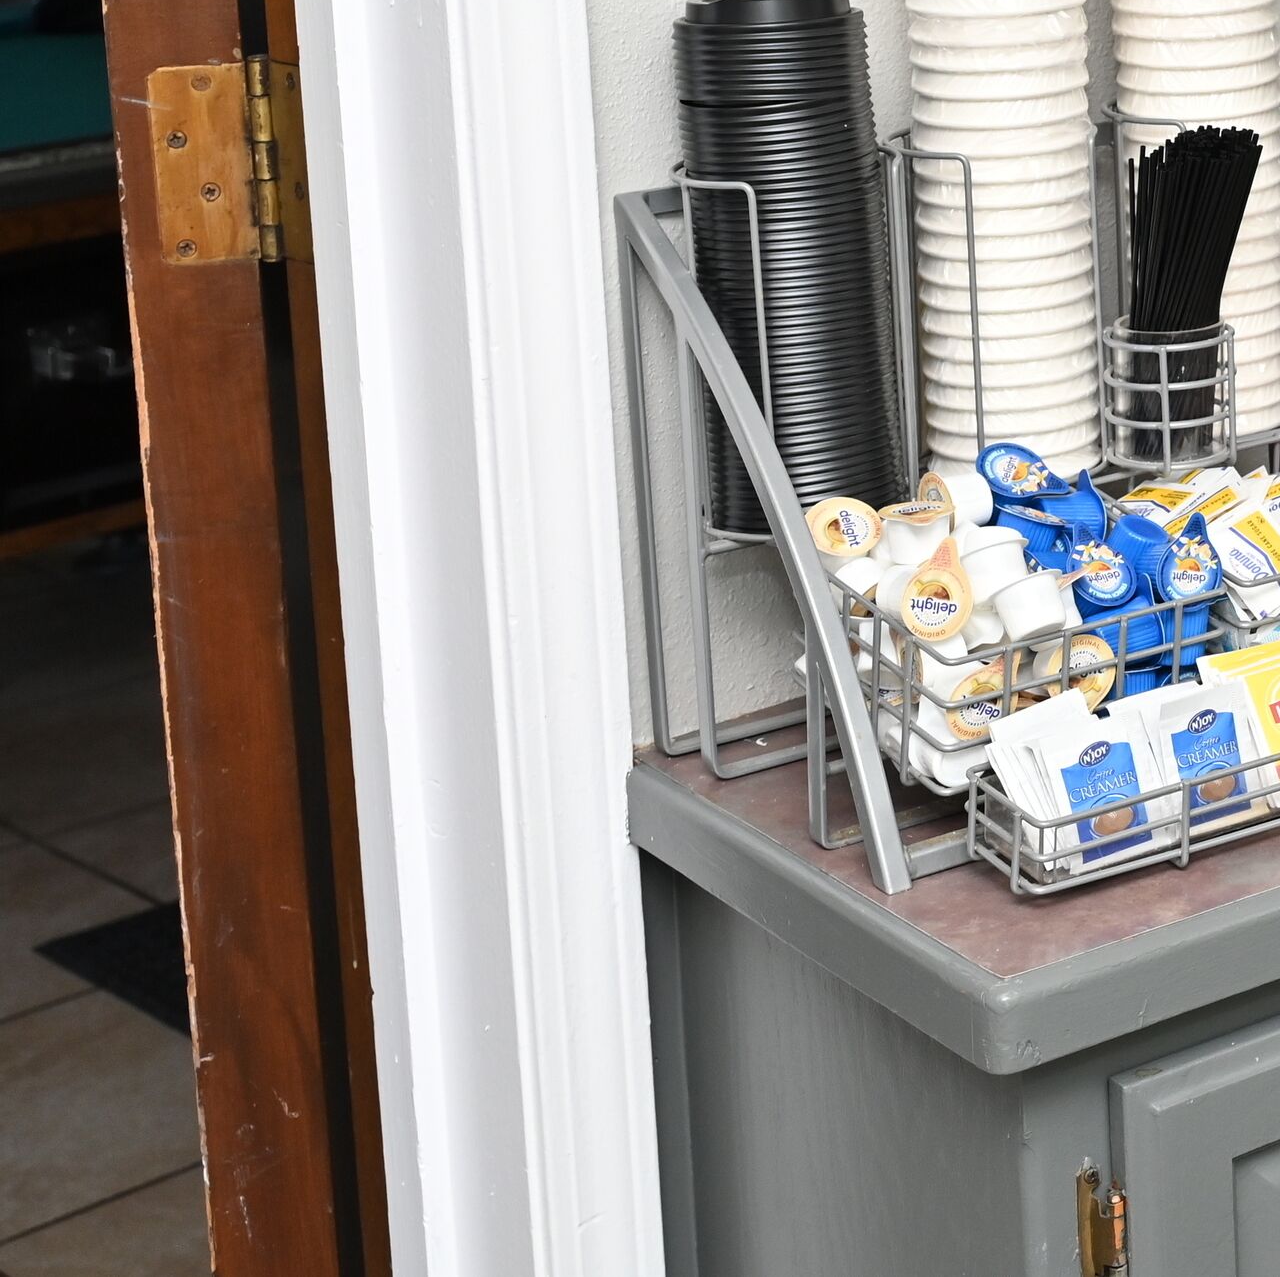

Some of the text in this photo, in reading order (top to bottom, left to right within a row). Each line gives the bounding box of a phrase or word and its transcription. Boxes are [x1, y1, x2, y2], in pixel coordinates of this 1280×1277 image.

[840, 510, 861, 547] delight
[1087, 571, 1120, 583] delight
[1172, 571, 1206, 584] delight
[910, 597, 957, 616] delight
[910, 625, 946, 638] ORIGINAL
[1072, 639, 1100, 649] RIGINAL
[951, 720, 982, 737] ORIGINAL
[1177, 740, 1238, 767] CREAMER
[1070, 771, 1137, 803] CREAMER
